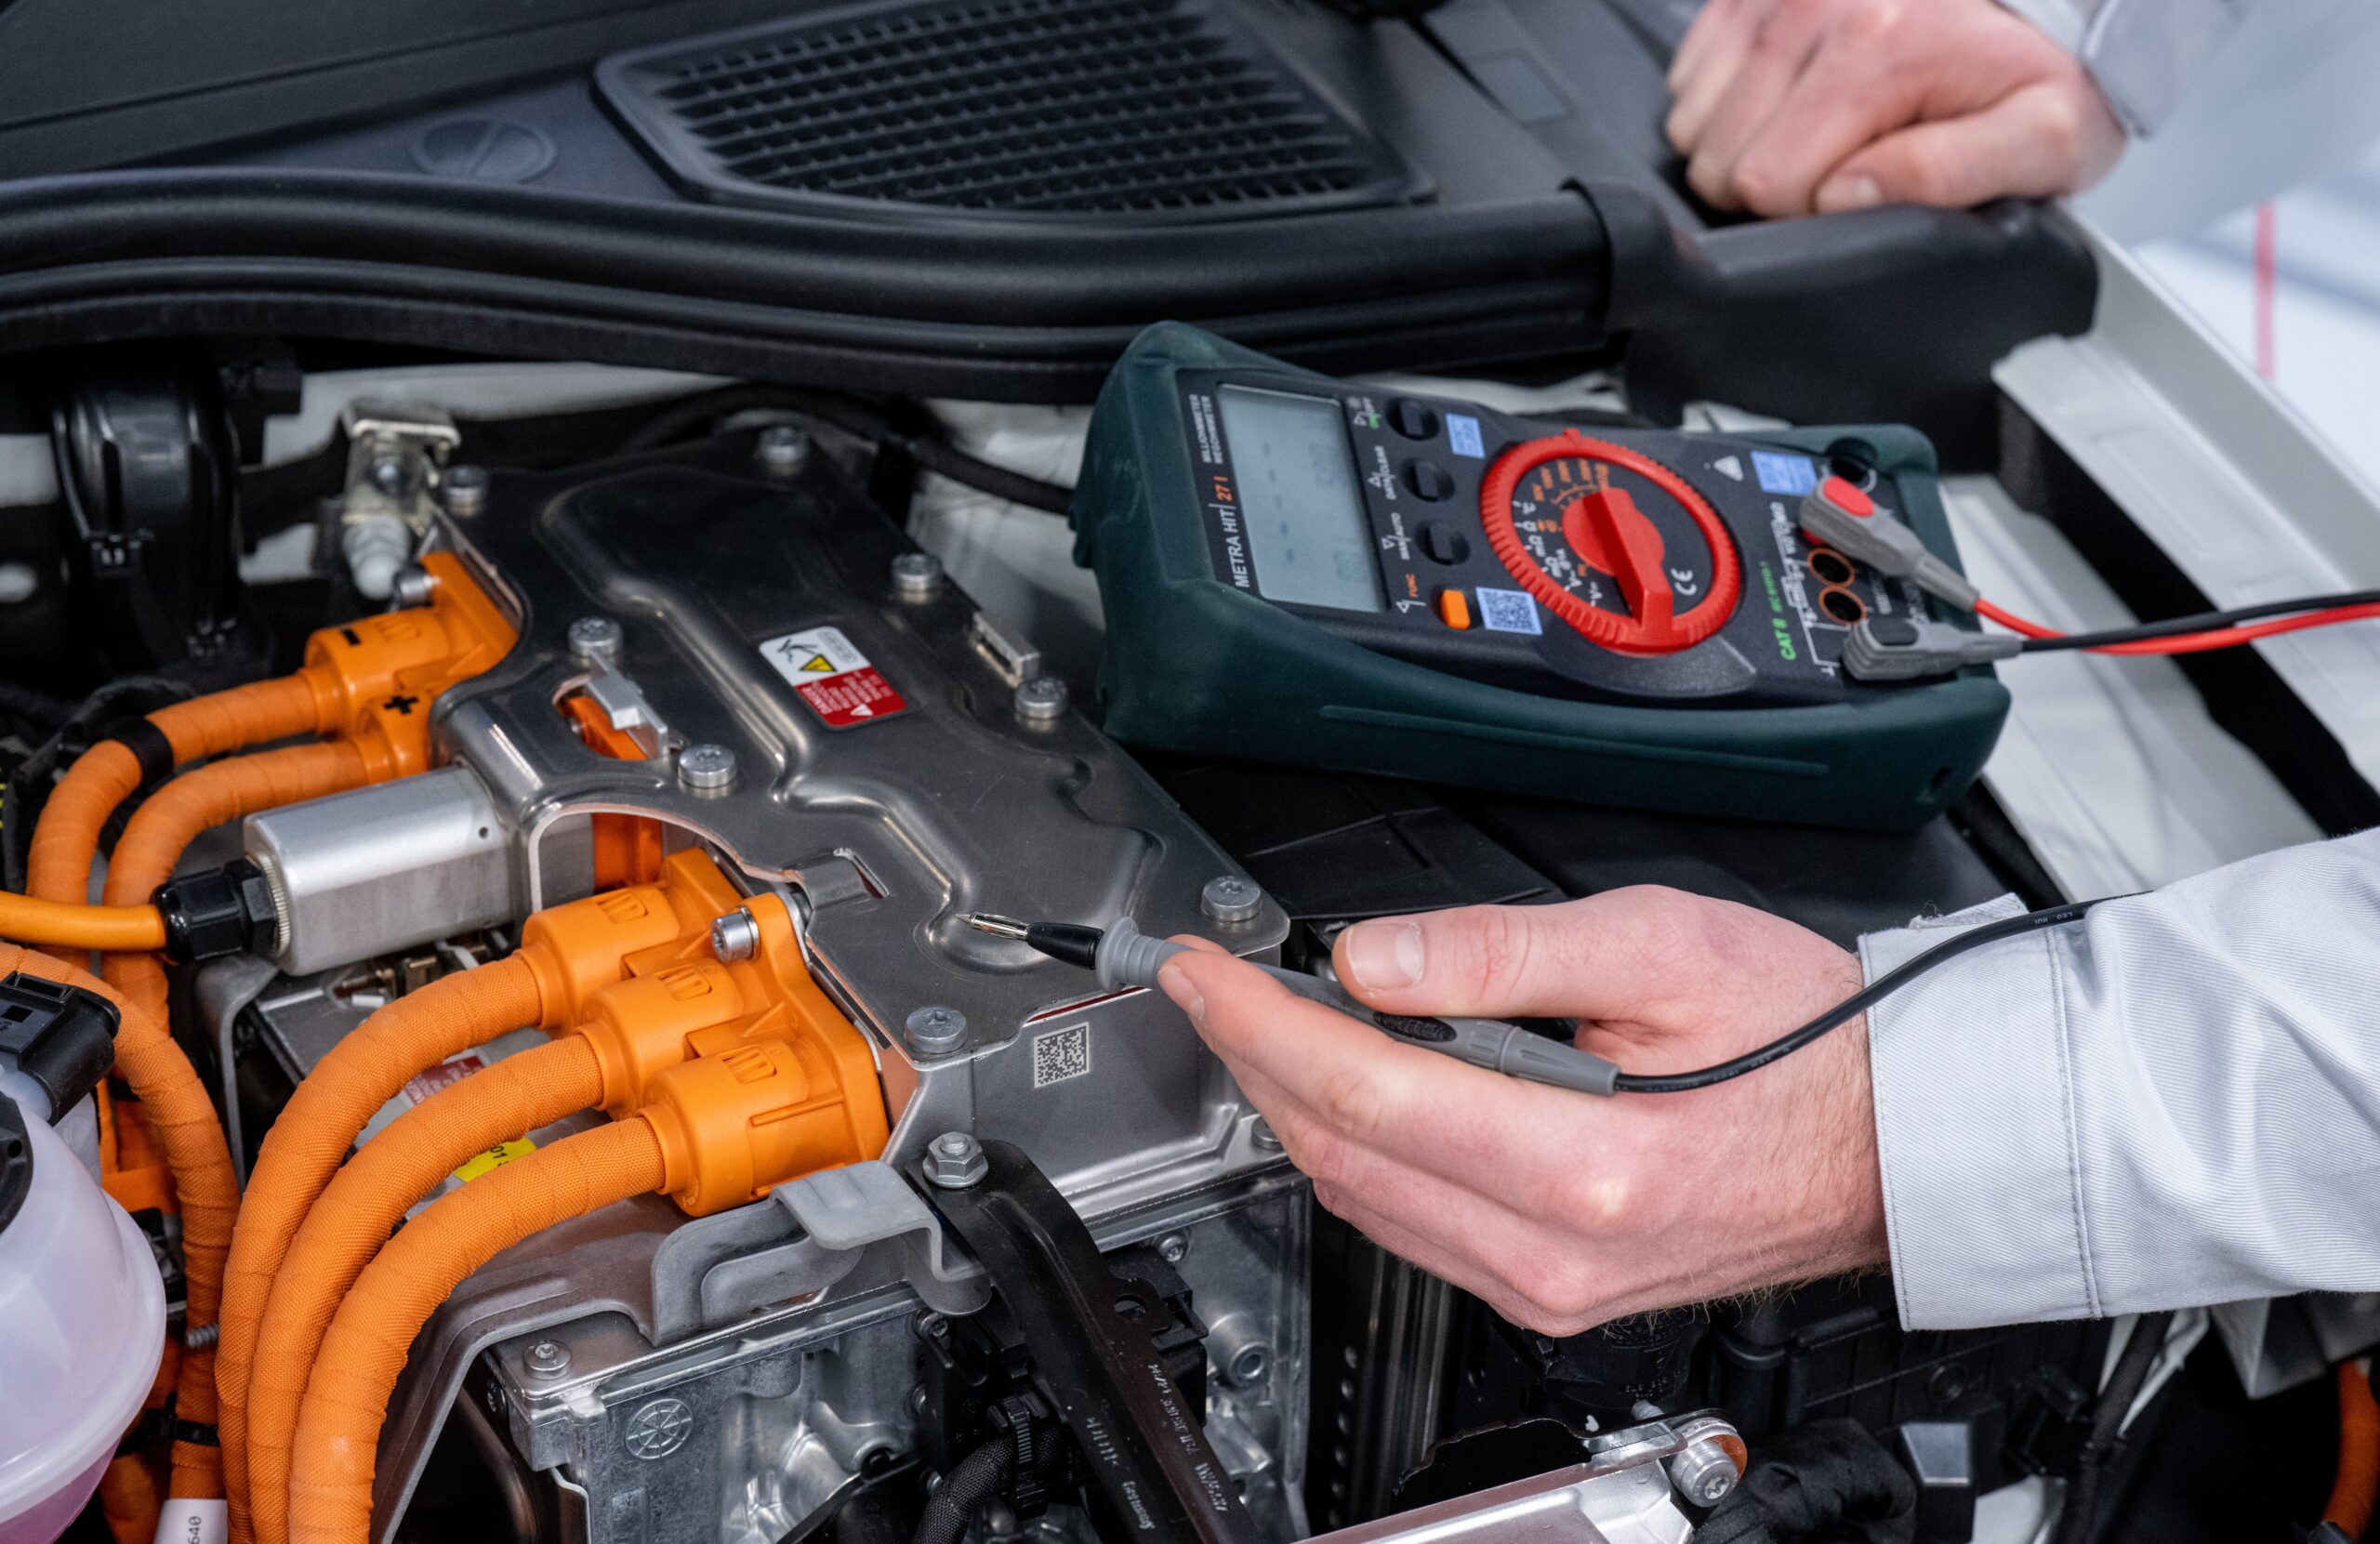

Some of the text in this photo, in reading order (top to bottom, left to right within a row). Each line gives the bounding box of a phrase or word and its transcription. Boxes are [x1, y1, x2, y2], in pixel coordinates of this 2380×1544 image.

[1219, 509, 1237, 533] HIT
[1226, 536, 1250, 587] METRA
[1671, 568, 1697, 595] CE
[1775, 631, 1796, 660] CAT
